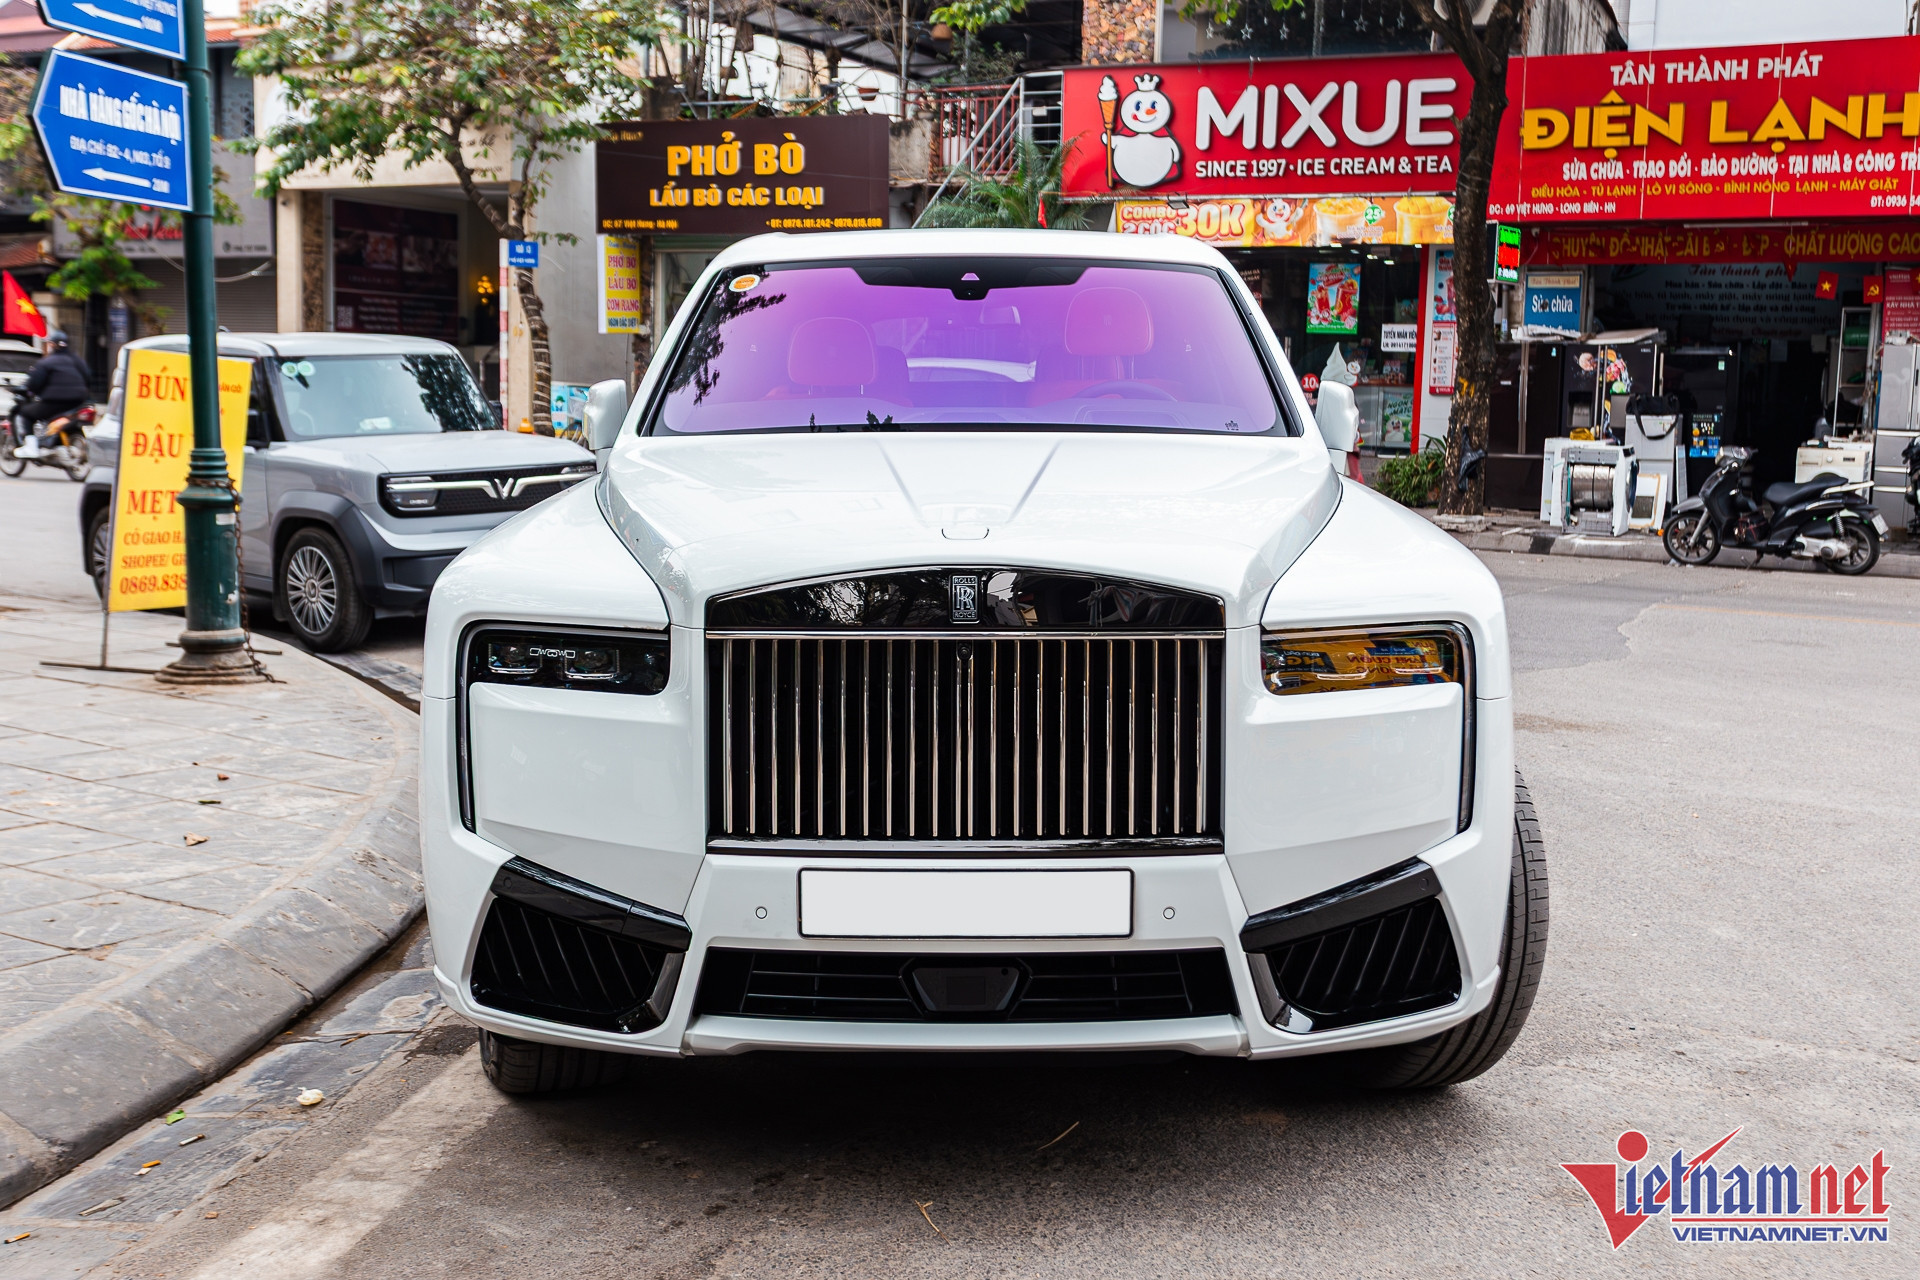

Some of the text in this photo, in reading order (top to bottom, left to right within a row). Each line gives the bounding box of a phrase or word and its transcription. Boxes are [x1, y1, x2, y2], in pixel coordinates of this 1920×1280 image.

[1611, 50, 1823, 86] TÂN THÀNH PHÁT
[60, 82, 89, 121] NHÀ
[89, 88, 121, 128] HÀNG
[144, 100, 161, 137] HÀ
[162, 104, 182, 145] NỘI
[1196, 78, 1457, 150] MIXUE
[1520, 89, 1920, 159] ĐIỆN LẠNH
[667, 130, 805, 176] PHỞ BÒ
[1196, 155, 1452, 178] SINCE 1997 ICE CREAM & TEA
[1563, 157, 1587, 180] SỬA
[1633, 159, 1665, 178] TRAO
[1701, 152, 1727, 176] BẢO
[1788, 155, 1808, 178] TẠI
[1812, 150, 1840, 173] NHÀ
[1843, 153, 1852, 172] &
[1855, 149, 1895, 171] CÔNG
[650, 181, 824, 210] LẨU BÒ CÁC LOẠI
[1531, 176, 1899, 198] ĐIỀU HÒA TỦ LẠNH LÒ VI SÓNG BÌNH NÓNG LẠNH MÁY GIẶT
[1886, 195, 1907, 207] 0936
[1122, 204, 1244, 238] COMBO 30K
[1517, 202, 1531, 217] VIỆT
[1532, 202, 1554, 214] HƯNG
[1560, 202, 1581, 214] LONG
[1583, 200, 1599, 213] BIÊN
[1604, 202, 1616, 213] HN
[1784, 227, 1826, 256] CHẤT
[1830, 230, 1884, 259] LƯỢNG
[1552, 294, 1573, 313] chữa
[136, 366, 188, 400] BÚN
[132, 423, 181, 463] ĐẬU
[126, 490, 182, 520] MẸT
[142, 530, 171, 545] GIAO
[172, 530, 187, 544] H
